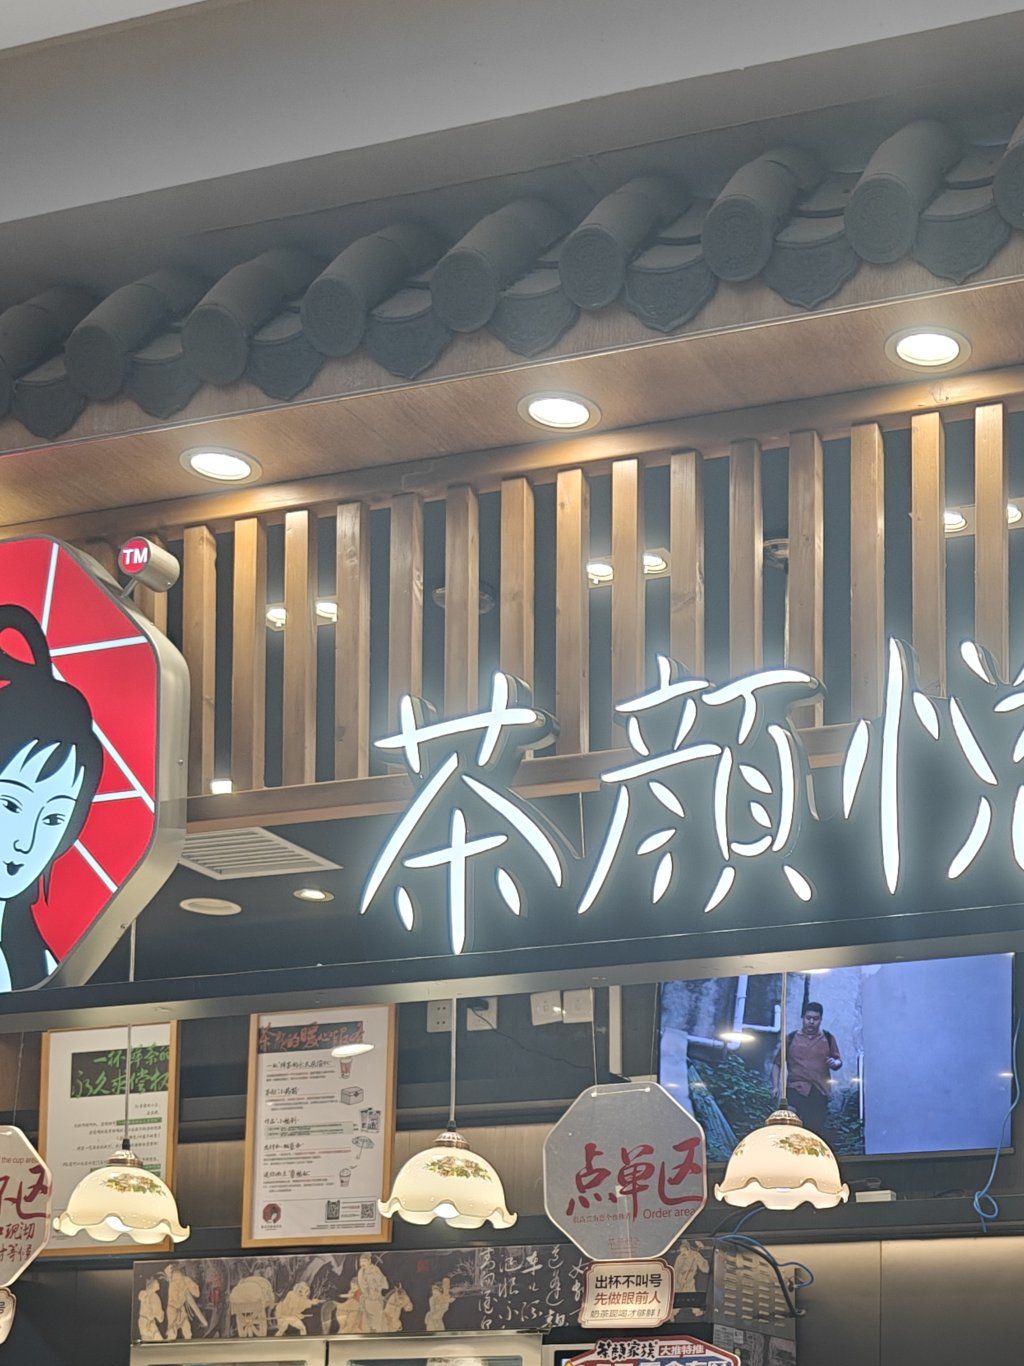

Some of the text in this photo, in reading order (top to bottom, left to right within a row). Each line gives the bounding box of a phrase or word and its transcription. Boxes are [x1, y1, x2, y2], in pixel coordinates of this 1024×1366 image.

[123, 548, 148, 564] TM
[566, 1137, 704, 1222] 点单区
[643, 1208, 671, 1219] Order
[674, 1207, 695, 1218] area
[0, 1222, 35, 1241] 现沏
[594, 1273, 663, 1289] 出杯不叫号
[593, 1291, 661, 1306] 先做眼前人
